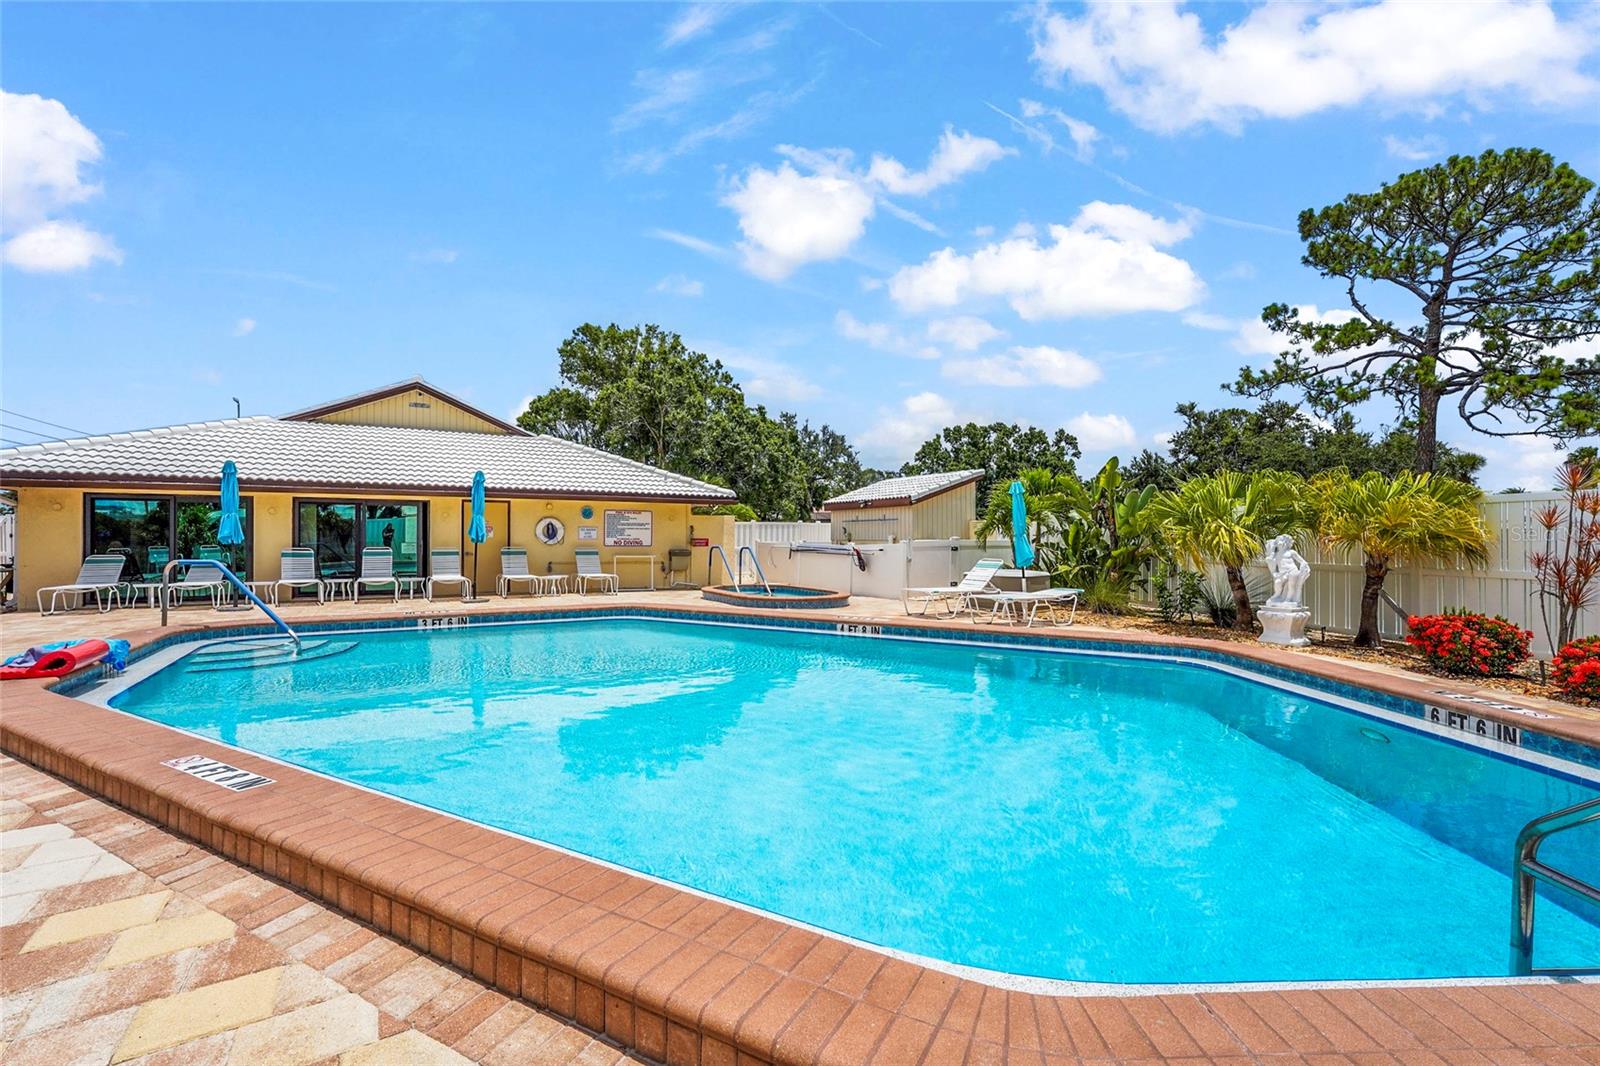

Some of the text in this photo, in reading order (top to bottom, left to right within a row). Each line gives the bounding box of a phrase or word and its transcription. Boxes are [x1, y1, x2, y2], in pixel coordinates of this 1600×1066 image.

[432, 618, 443, 626] FT
[840, 624, 844, 632] 4
[871, 626, 880, 634] IN
[1430, 708, 1518, 745] 6 FT 6 IN
[192, 765, 239, 778] FT
[226, 776, 273, 790] IN
